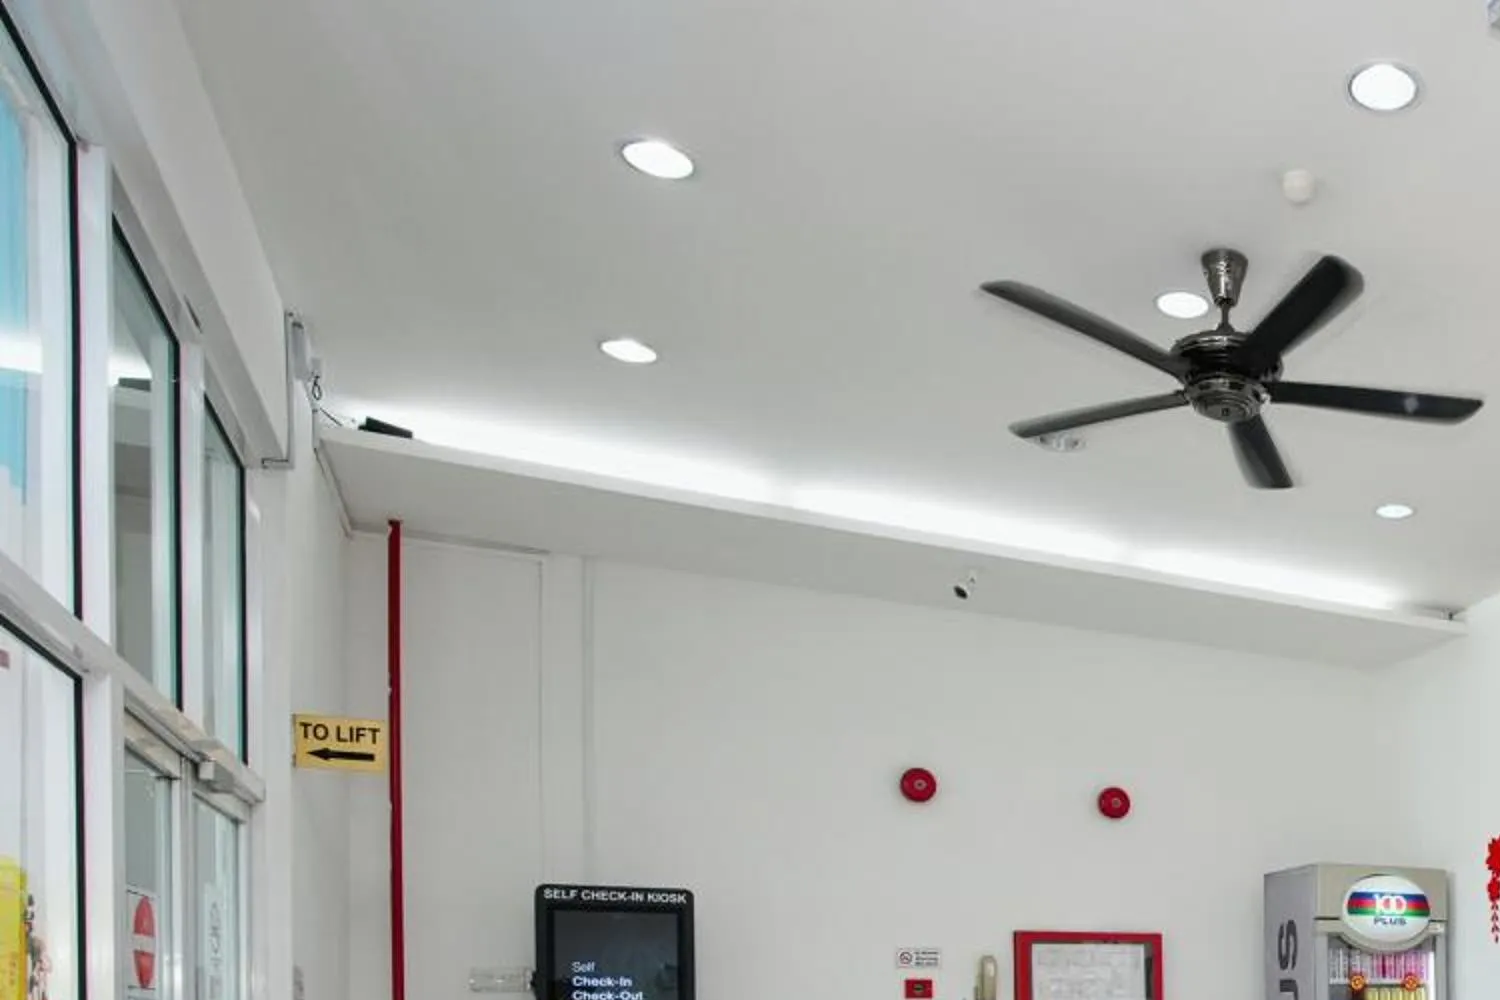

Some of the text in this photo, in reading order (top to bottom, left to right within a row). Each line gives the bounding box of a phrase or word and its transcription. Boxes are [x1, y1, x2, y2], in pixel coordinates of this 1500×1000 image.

[299, 721, 381, 744] TO LIFT
[544, 888, 687, 904] SELF CHECK-IN KIOSK
[1374, 893, 1408, 914] 100
[1373, 917, 1407, 926] PLUS
[572, 961, 597, 973] Self
[572, 976, 633, 987] Check-In
[572, 991, 644, 1000] Check-Out
